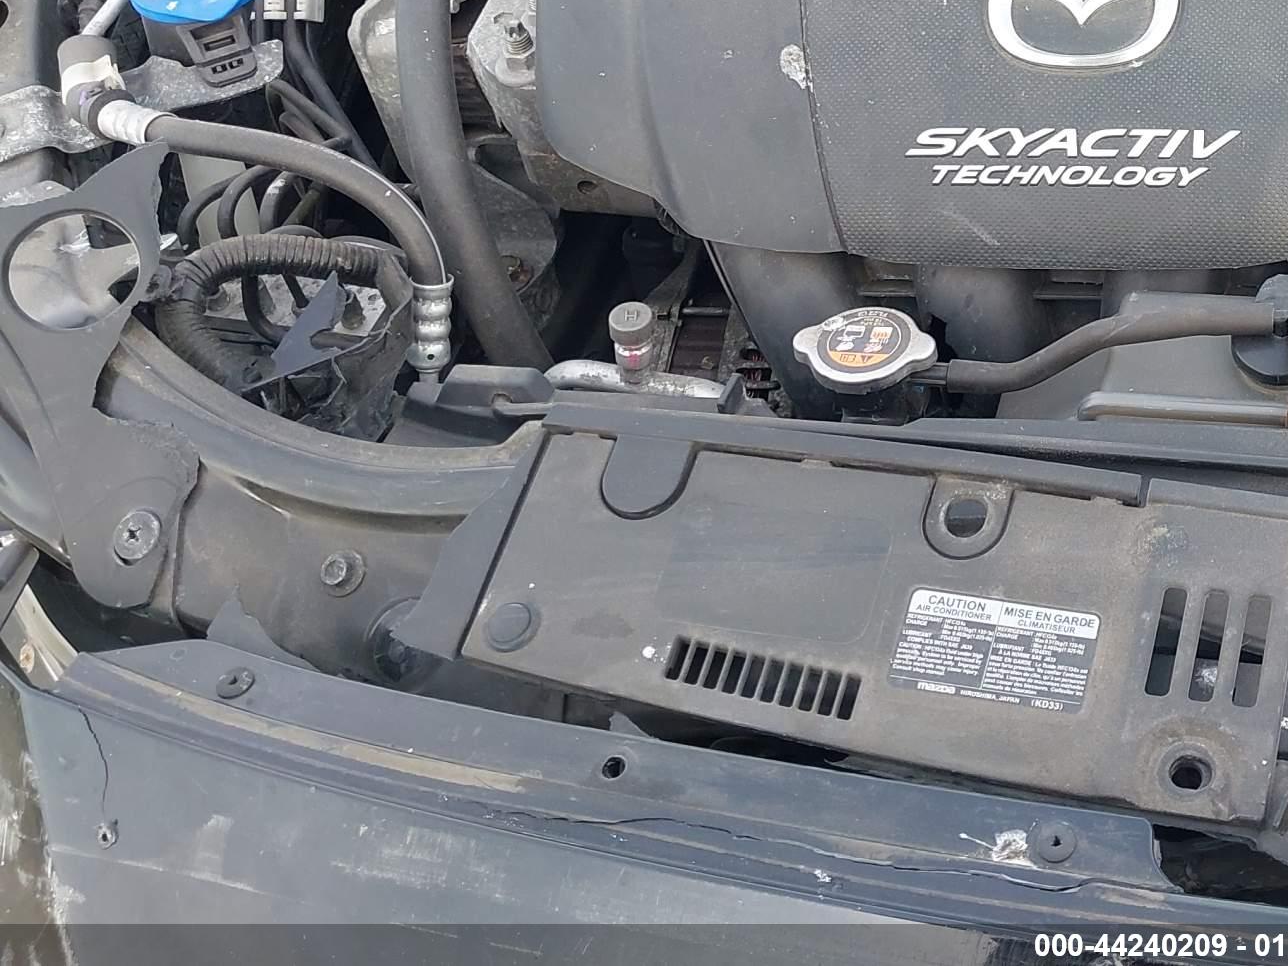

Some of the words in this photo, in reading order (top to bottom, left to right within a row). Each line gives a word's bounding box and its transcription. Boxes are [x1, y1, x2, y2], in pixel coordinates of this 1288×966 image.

[905, 127, 1242, 159] SKYACTIV
[931, 164, 1210, 187] TECHNOLOGY
[624, 310, 638, 321] H
[916, 604, 931, 612] AIR
[933, 607, 992, 621] CONDITIONER
[928, 595, 986, 612] CAUTION
[1004, 607, 1033, 619] MISE
[1035, 611, 1052, 622] EN
[1053, 614, 1096, 628] GARDE
[1017, 619, 1076, 634] CLIMATISEUR
[917, 682, 956, 695] mazda
[1031, 698, 1064, 711] (KD33)
